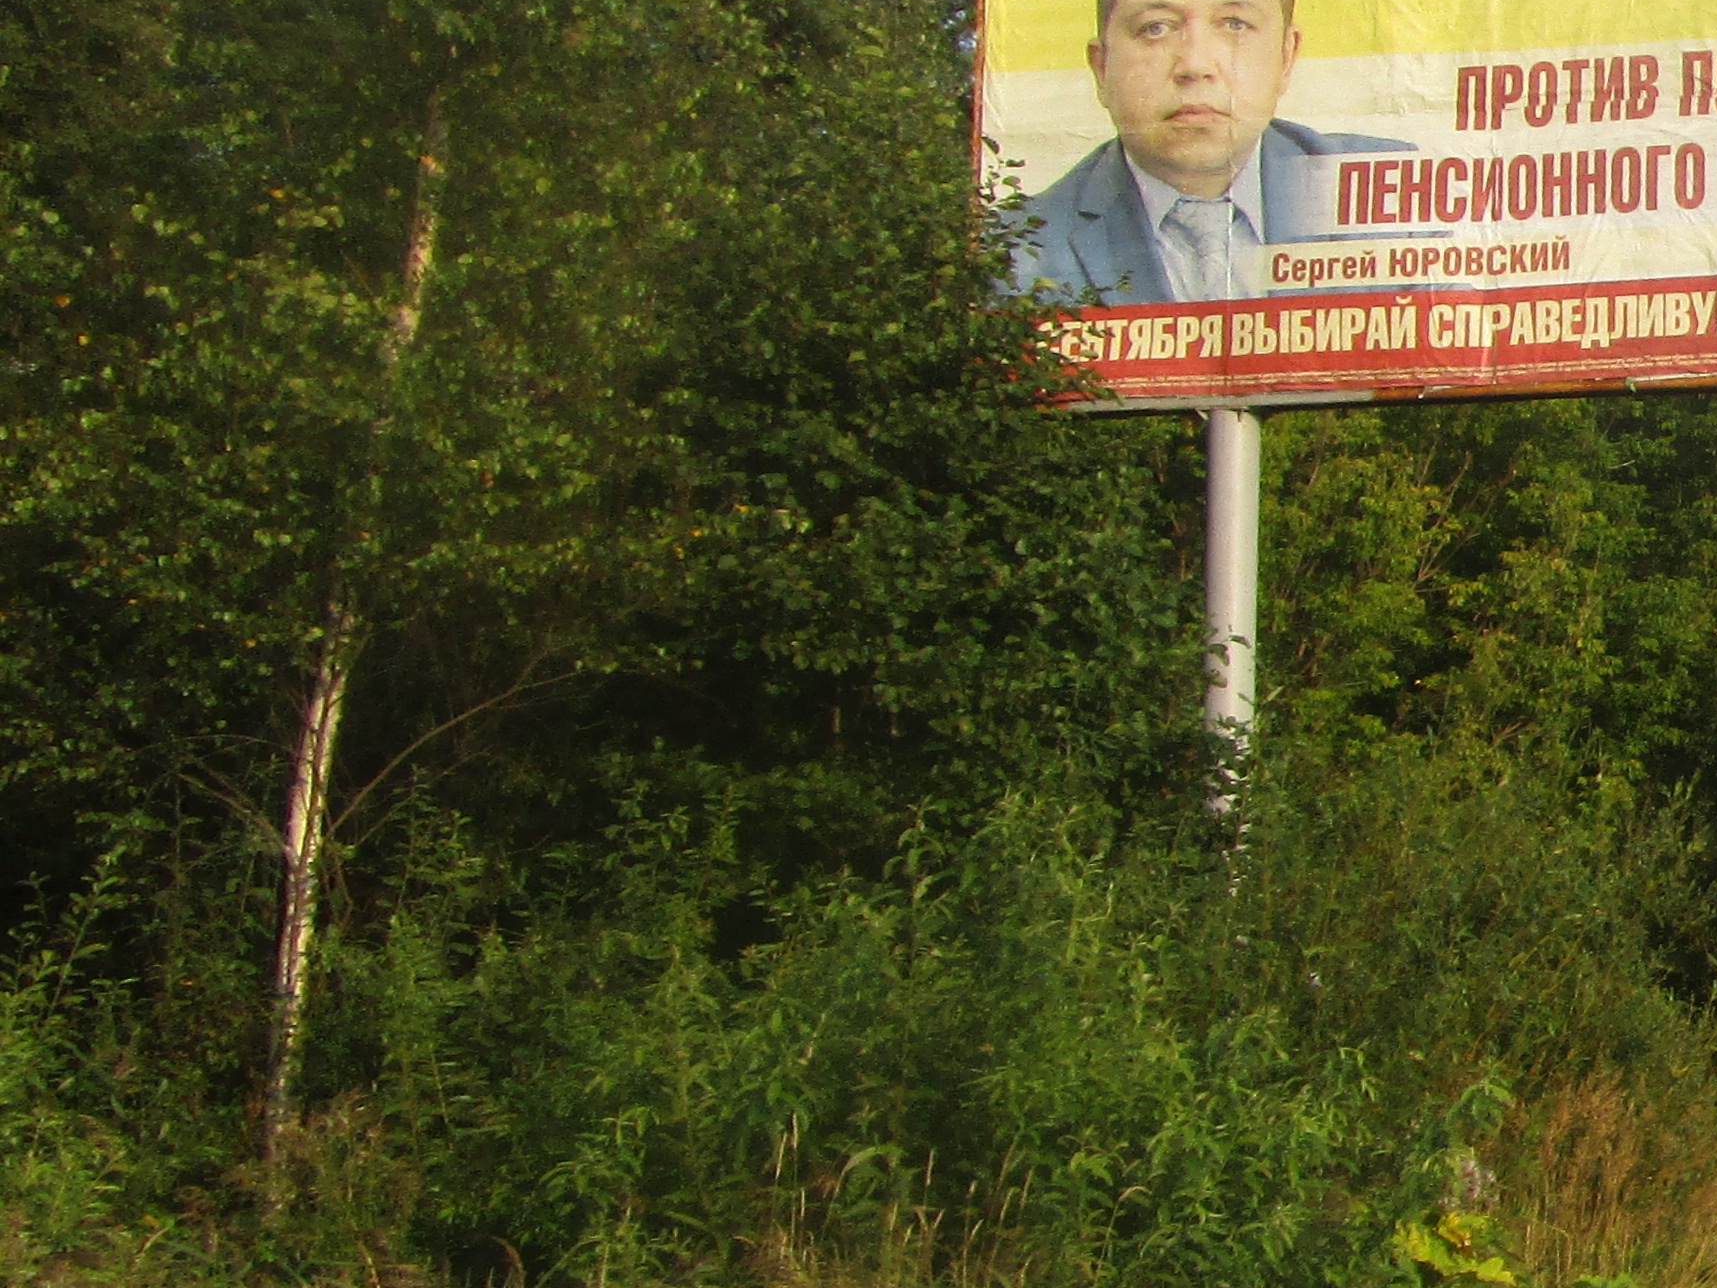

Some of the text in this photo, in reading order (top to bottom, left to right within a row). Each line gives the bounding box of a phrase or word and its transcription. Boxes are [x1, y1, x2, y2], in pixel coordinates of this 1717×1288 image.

[1456, 54, 1659, 131] ПРОТИВ
[1336, 142, 1706, 225] ПЕНСИОННОГО
[1272, 235, 1571, 287] Сергей ЮРОВСКИЙ
[1230, 295, 1417, 357] ВЫБИРАЙ
